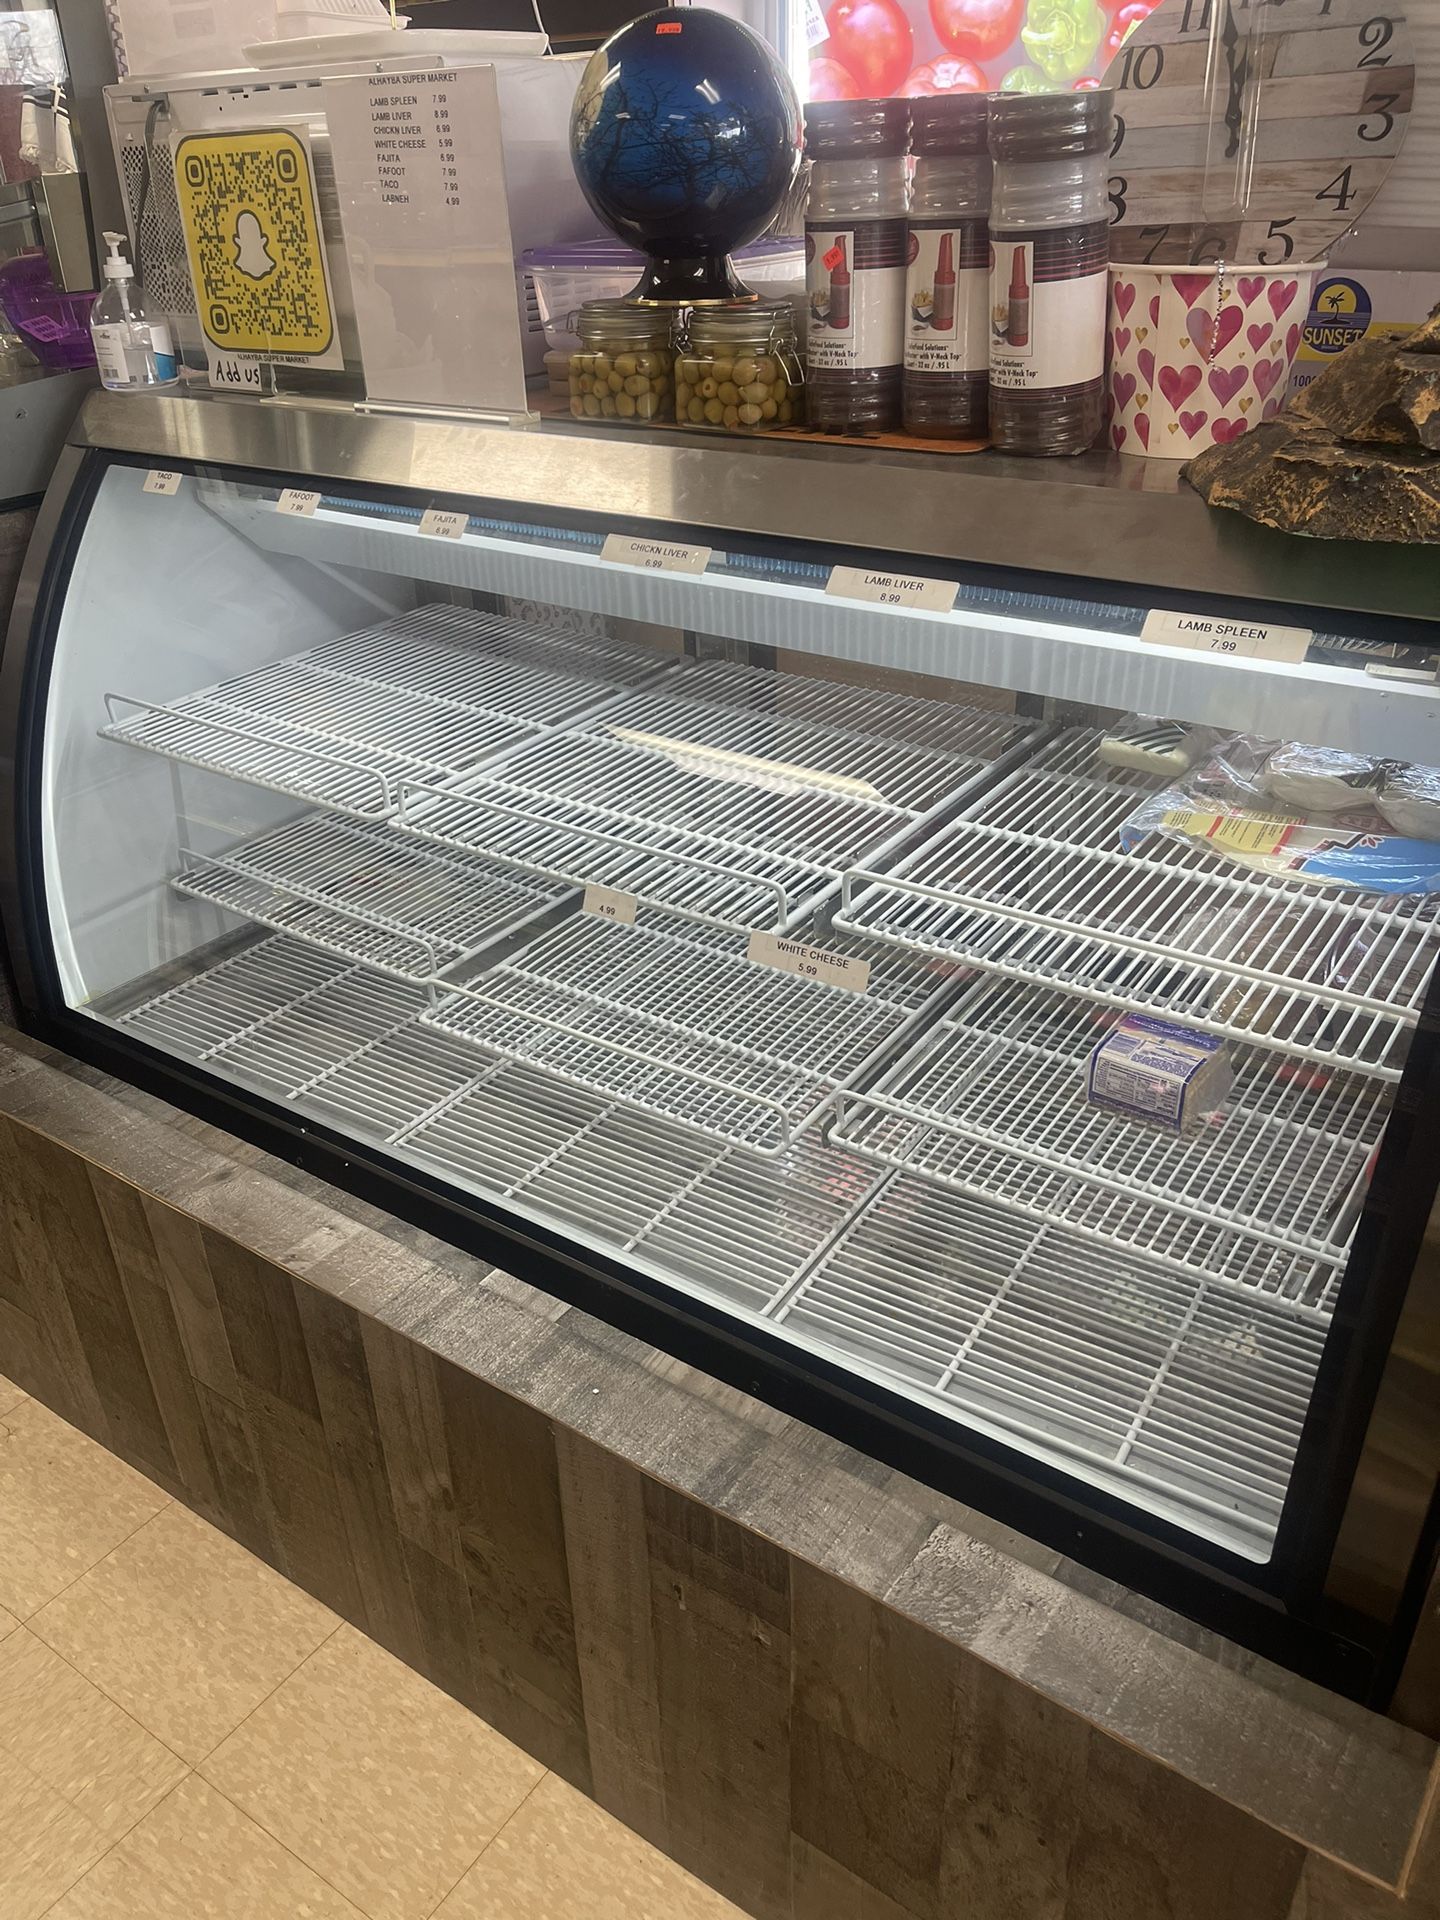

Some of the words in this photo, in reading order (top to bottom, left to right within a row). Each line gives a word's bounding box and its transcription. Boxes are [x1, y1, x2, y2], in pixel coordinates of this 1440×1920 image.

[1357, 16, 1393, 69] 2
[1116, 44, 1164, 90] 10
[402, 75, 426, 84] SUPER
[427, 73, 457, 82] MARKET
[370, 98, 389, 106] LAMB
[390, 96, 418, 105] SPLEEN
[432, 95, 447, 103] 7.99
[372, 112, 391, 121] LAMB
[392, 111, 412, 120] LIVER
[434, 110, 448, 118] 8.99
[1357, 93, 1400, 142] 3
[374, 126, 400, 135] CHICKN
[401, 126, 422, 135] LIVER
[375, 140, 397, 149] WHITE
[398, 140, 426, 148] CHEESE
[439, 139, 453, 147] 5.99
[377, 154, 401, 162] FAJITA
[378, 167, 406, 176] FAFOOT
[442, 168, 456, 176] 7.99
[380, 180, 399, 189] TACO
[444, 183, 458, 191] 7.99
[1315, 164, 1357, 211] 4
[382, 194, 409, 203] LABNEH
[446, 197, 460, 206] 4.99
[1139, 226, 1170, 265] 7
[1257, 216, 1297, 266] 5
[1303, 327, 1363, 346] SUNSET
[263, 354, 285, 362] SUPER
[285, 355, 310, 364] MARKET
[216, 360, 242, 382] Add
[245, 367, 260, 384] us
[157, 472, 173, 480] TACO
[289, 491, 315, 502] FAFOOT
[290, 503, 304, 512] 7.99
[434, 514, 458, 525] FAJITA
[435, 525, 451, 535] 6.99
[630, 542, 662, 556] CHICKN
[662, 547, 689, 559] LIVER
[645, 559, 663, 569] 6.99
[864, 575, 893, 588] LAMB
[895, 579, 925, 591] LIVER
[880, 592, 901, 603] 8.99
[1177, 619, 1213, 633] LAMB
[1215, 624, 1268, 640] SPLEEN
[1210, 638, 1237, 652] 7.99
[599, 905, 616, 916] 4.99
[777, 940, 808, 958] WHITE
[809, 950, 850, 969] CHEESE
[798, 963, 818, 976] 5.99
